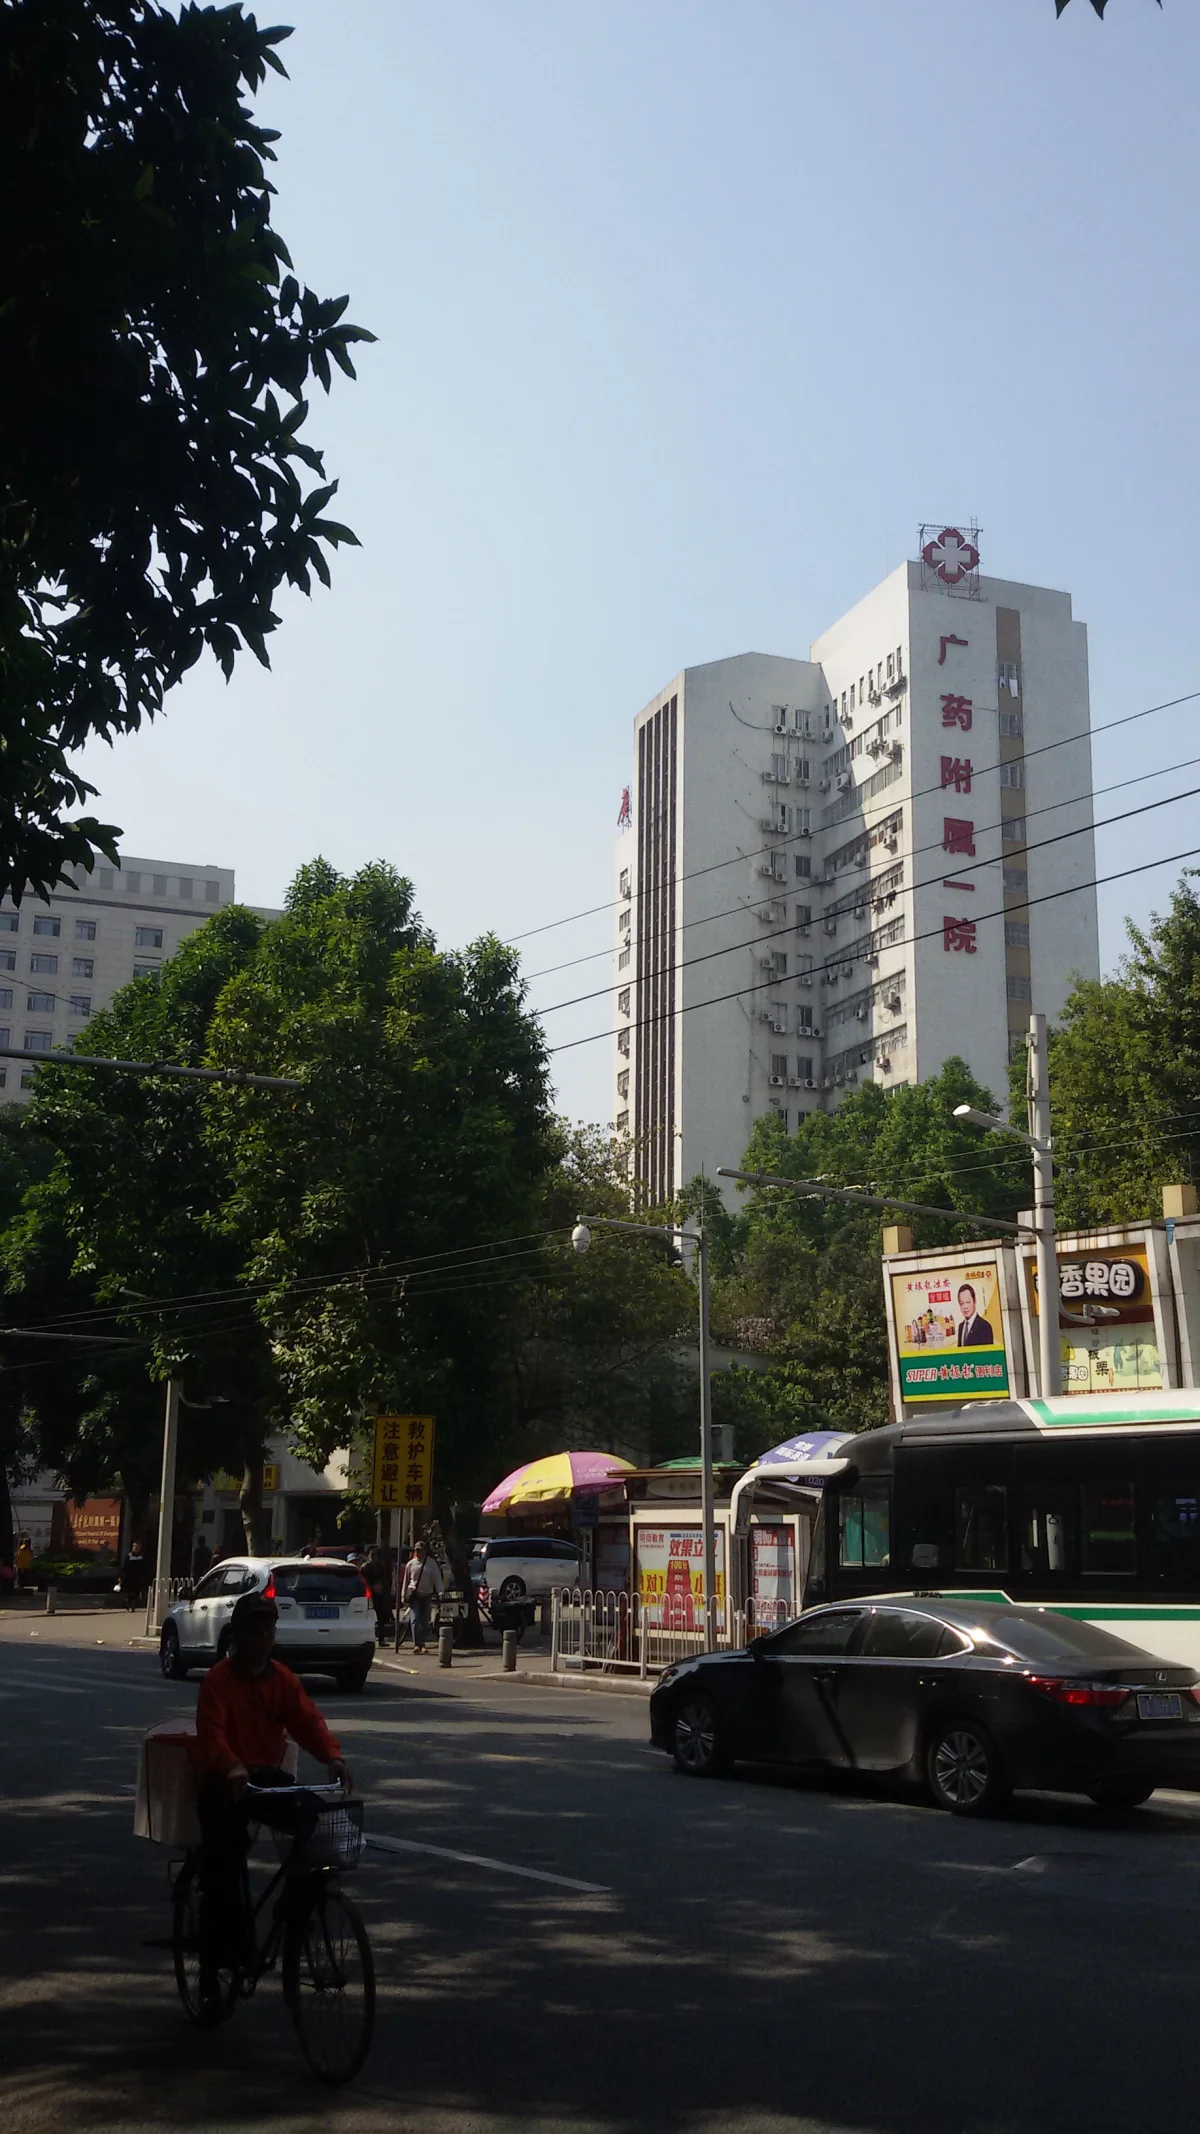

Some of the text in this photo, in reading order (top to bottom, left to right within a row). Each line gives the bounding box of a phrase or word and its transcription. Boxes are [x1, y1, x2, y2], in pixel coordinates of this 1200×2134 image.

[939, 634, 977, 953] 广药附属一院
[1035, 1261, 1135, 1297] 香果园
[906, 1369, 937, 1382] SUPER
[381, 1421, 400, 1502] 注意避让
[405, 1421, 425, 1502] 救护车辆
